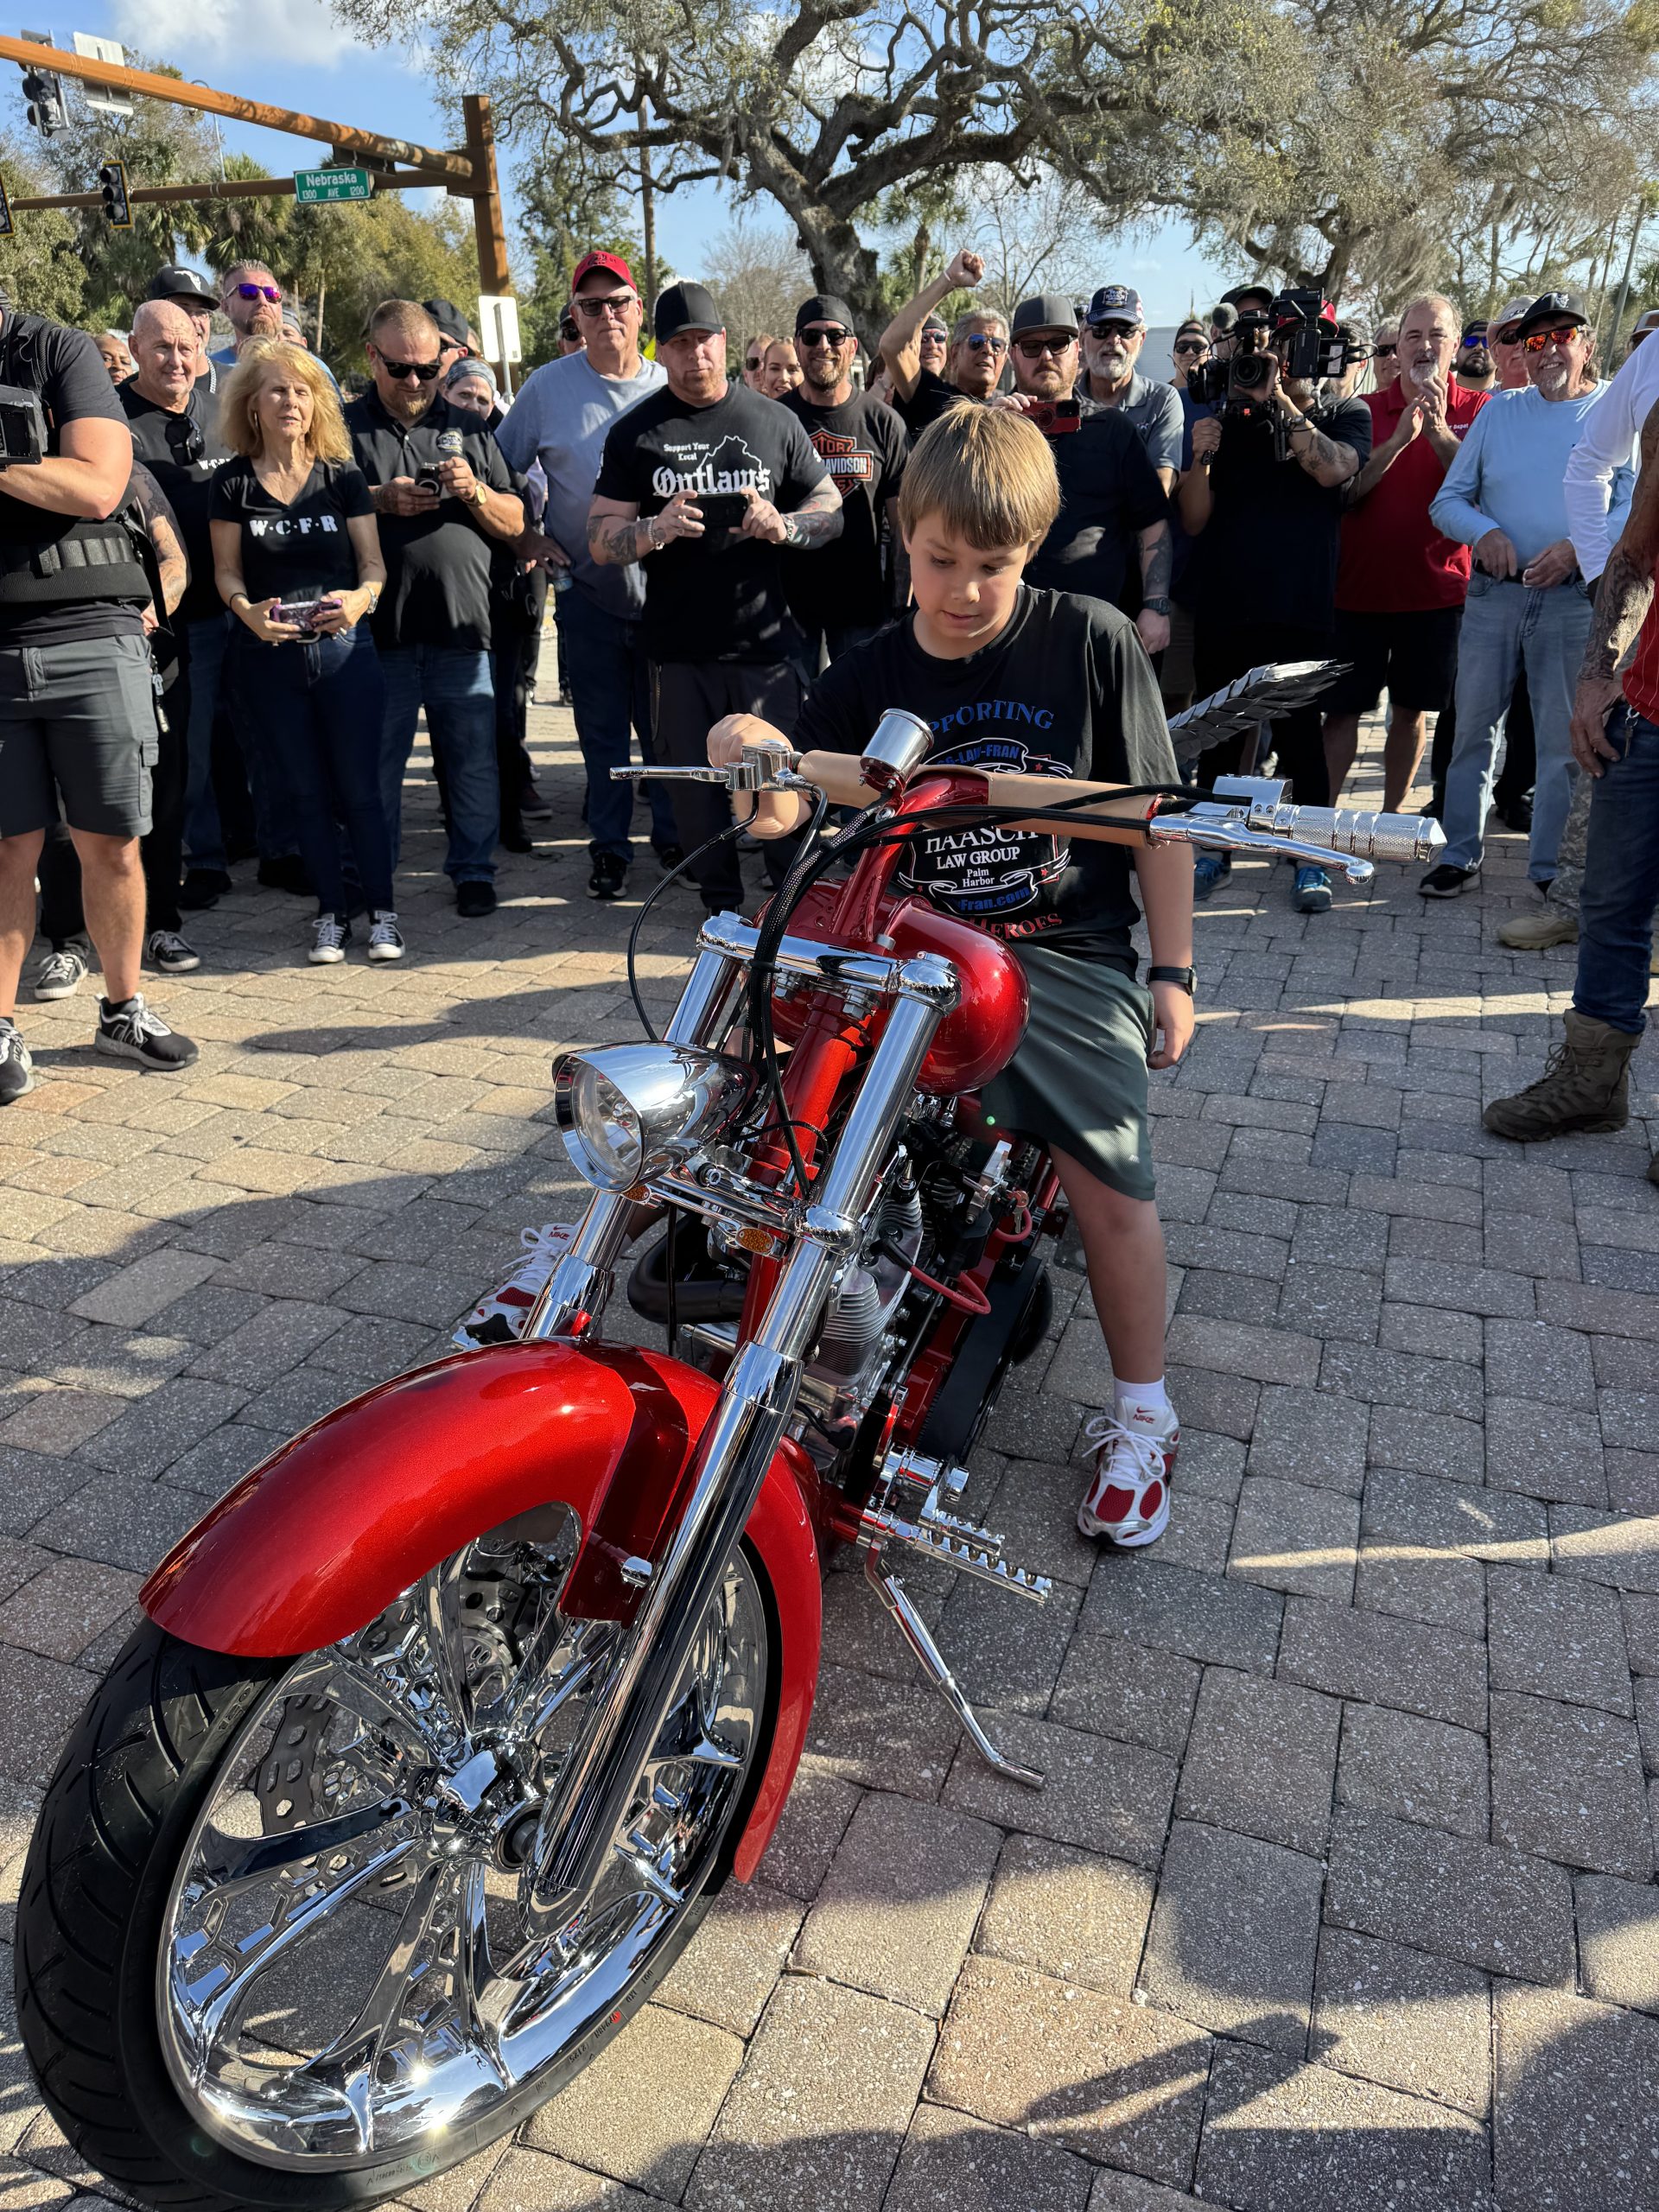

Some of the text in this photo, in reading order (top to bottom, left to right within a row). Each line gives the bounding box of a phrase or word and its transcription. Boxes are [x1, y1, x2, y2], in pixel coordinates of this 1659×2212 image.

[306, 172, 357, 187] Nebraska
[302, 186, 365, 200] 1300 AVE 1200
[664, 443, 692, 452] Support
[813, 436, 845, 453] TOR
[825, 457, 868, 474] AVIDSON
[652, 463, 771, 498] Outlaws
[927, 699, 1055, 734] PPORTING
[937, 847, 1020, 870] LAW GROUP
[967, 868, 989, 878] Palm
[962, 876, 995, 887] Harbor
[548, 1231, 569, 1241] NIKE
[1133, 1414, 1155, 1425] NIKE
